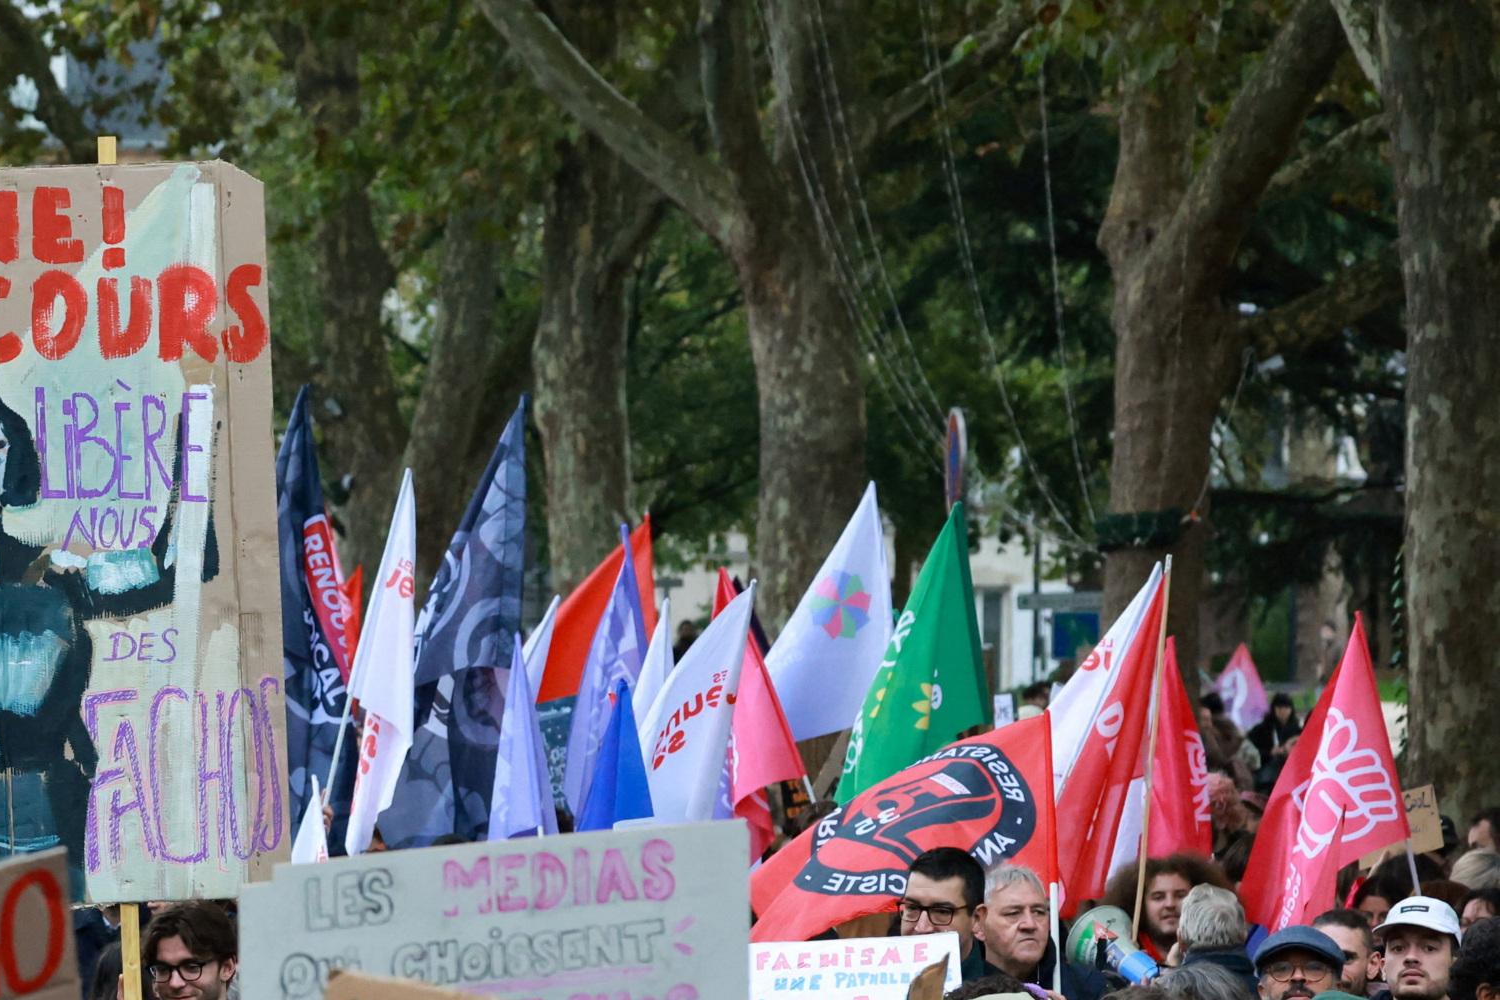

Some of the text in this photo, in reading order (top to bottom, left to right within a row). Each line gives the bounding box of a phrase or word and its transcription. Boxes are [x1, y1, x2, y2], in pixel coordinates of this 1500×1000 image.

[61, 506, 158, 551] NOUS
[103, 628, 179, 664] DES
[83, 676, 283, 875] FACHOS
[304, 868, 395, 932] LES
[442, 838, 677, 918] MEDIAS
